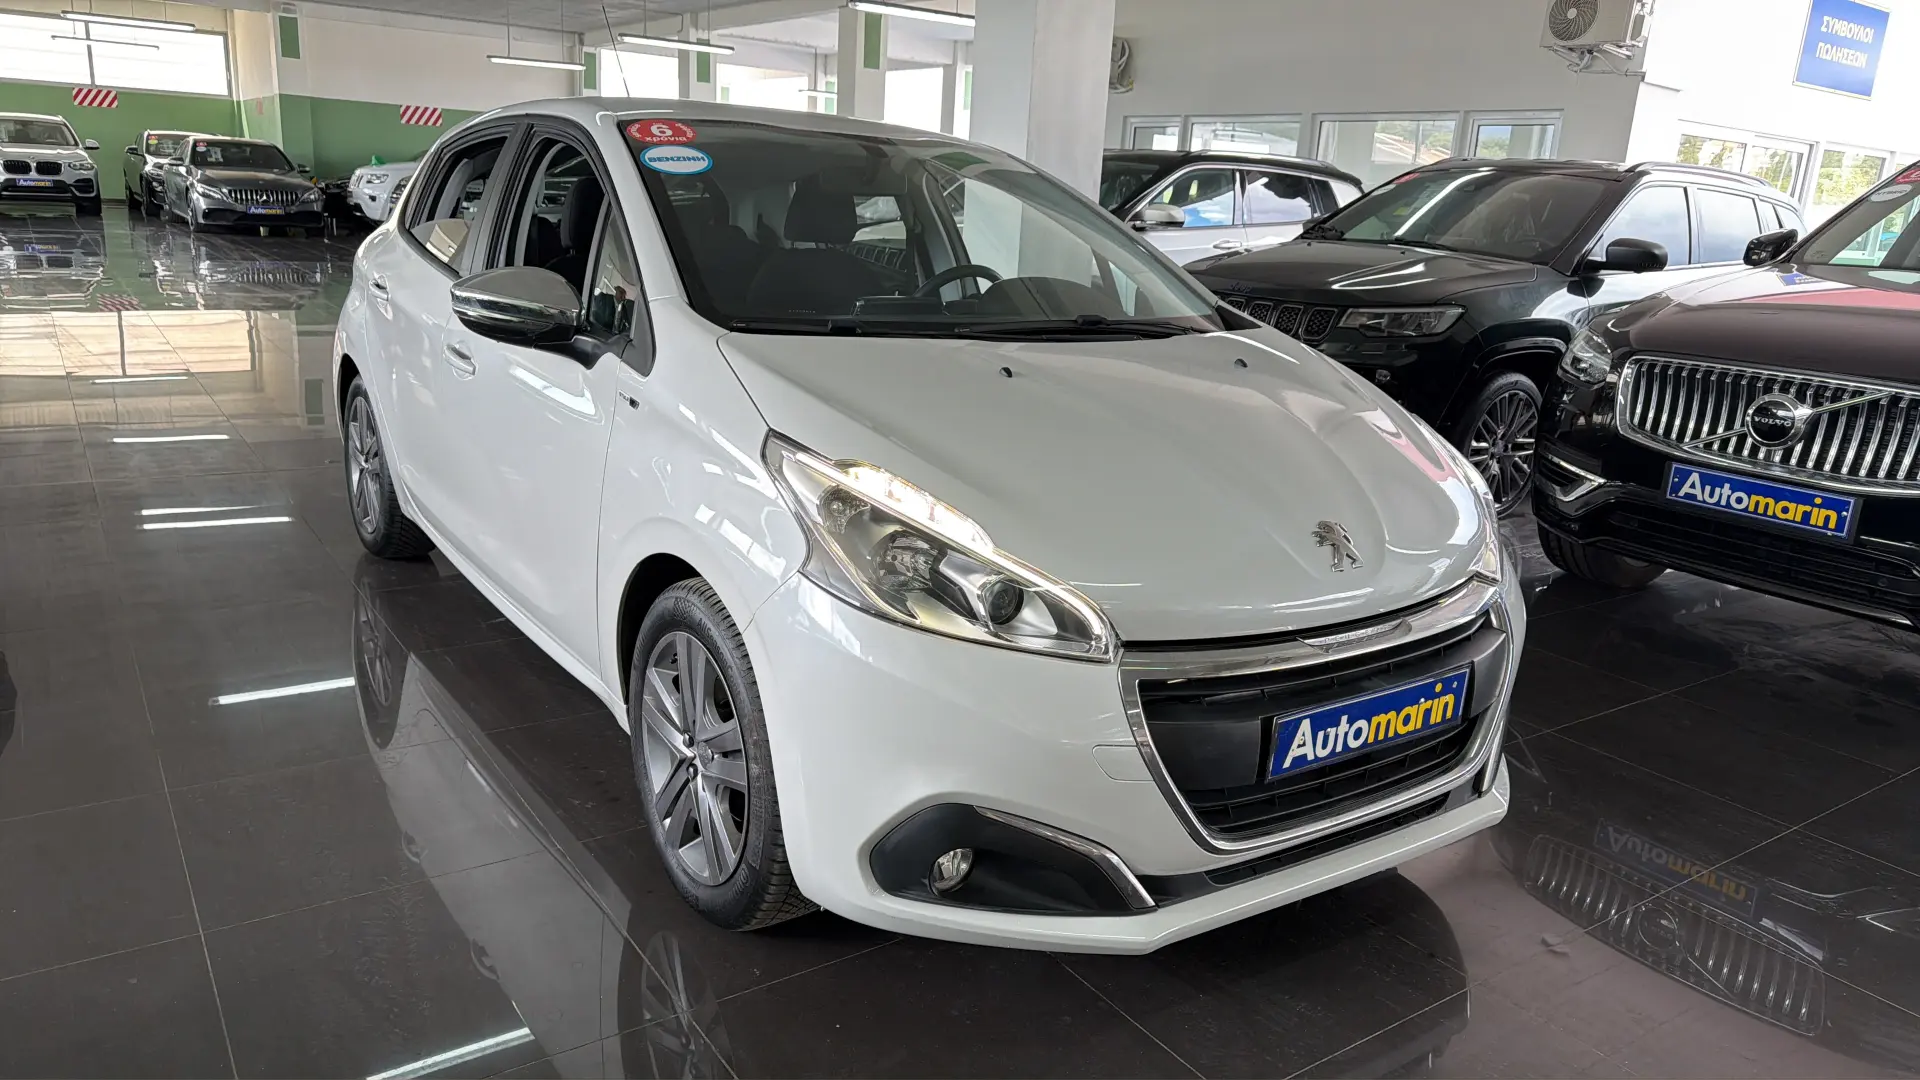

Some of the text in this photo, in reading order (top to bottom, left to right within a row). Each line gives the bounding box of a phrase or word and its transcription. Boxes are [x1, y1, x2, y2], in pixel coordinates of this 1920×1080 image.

[1821, 15, 1874, 44] ΣΥΜΒΟΥΛΟΙ
[1816, 41, 1868, 69] ΠΩΛΗΣΕΩΝ
[650, 124, 673, 137] 6
[647, 155, 706, 163] ΒΕΝΖΙΝΗ
[1753, 415, 1792, 427] VOLVO
[1677, 472, 1838, 530] Automarin
[1282, 682, 1455, 769] Automarin
